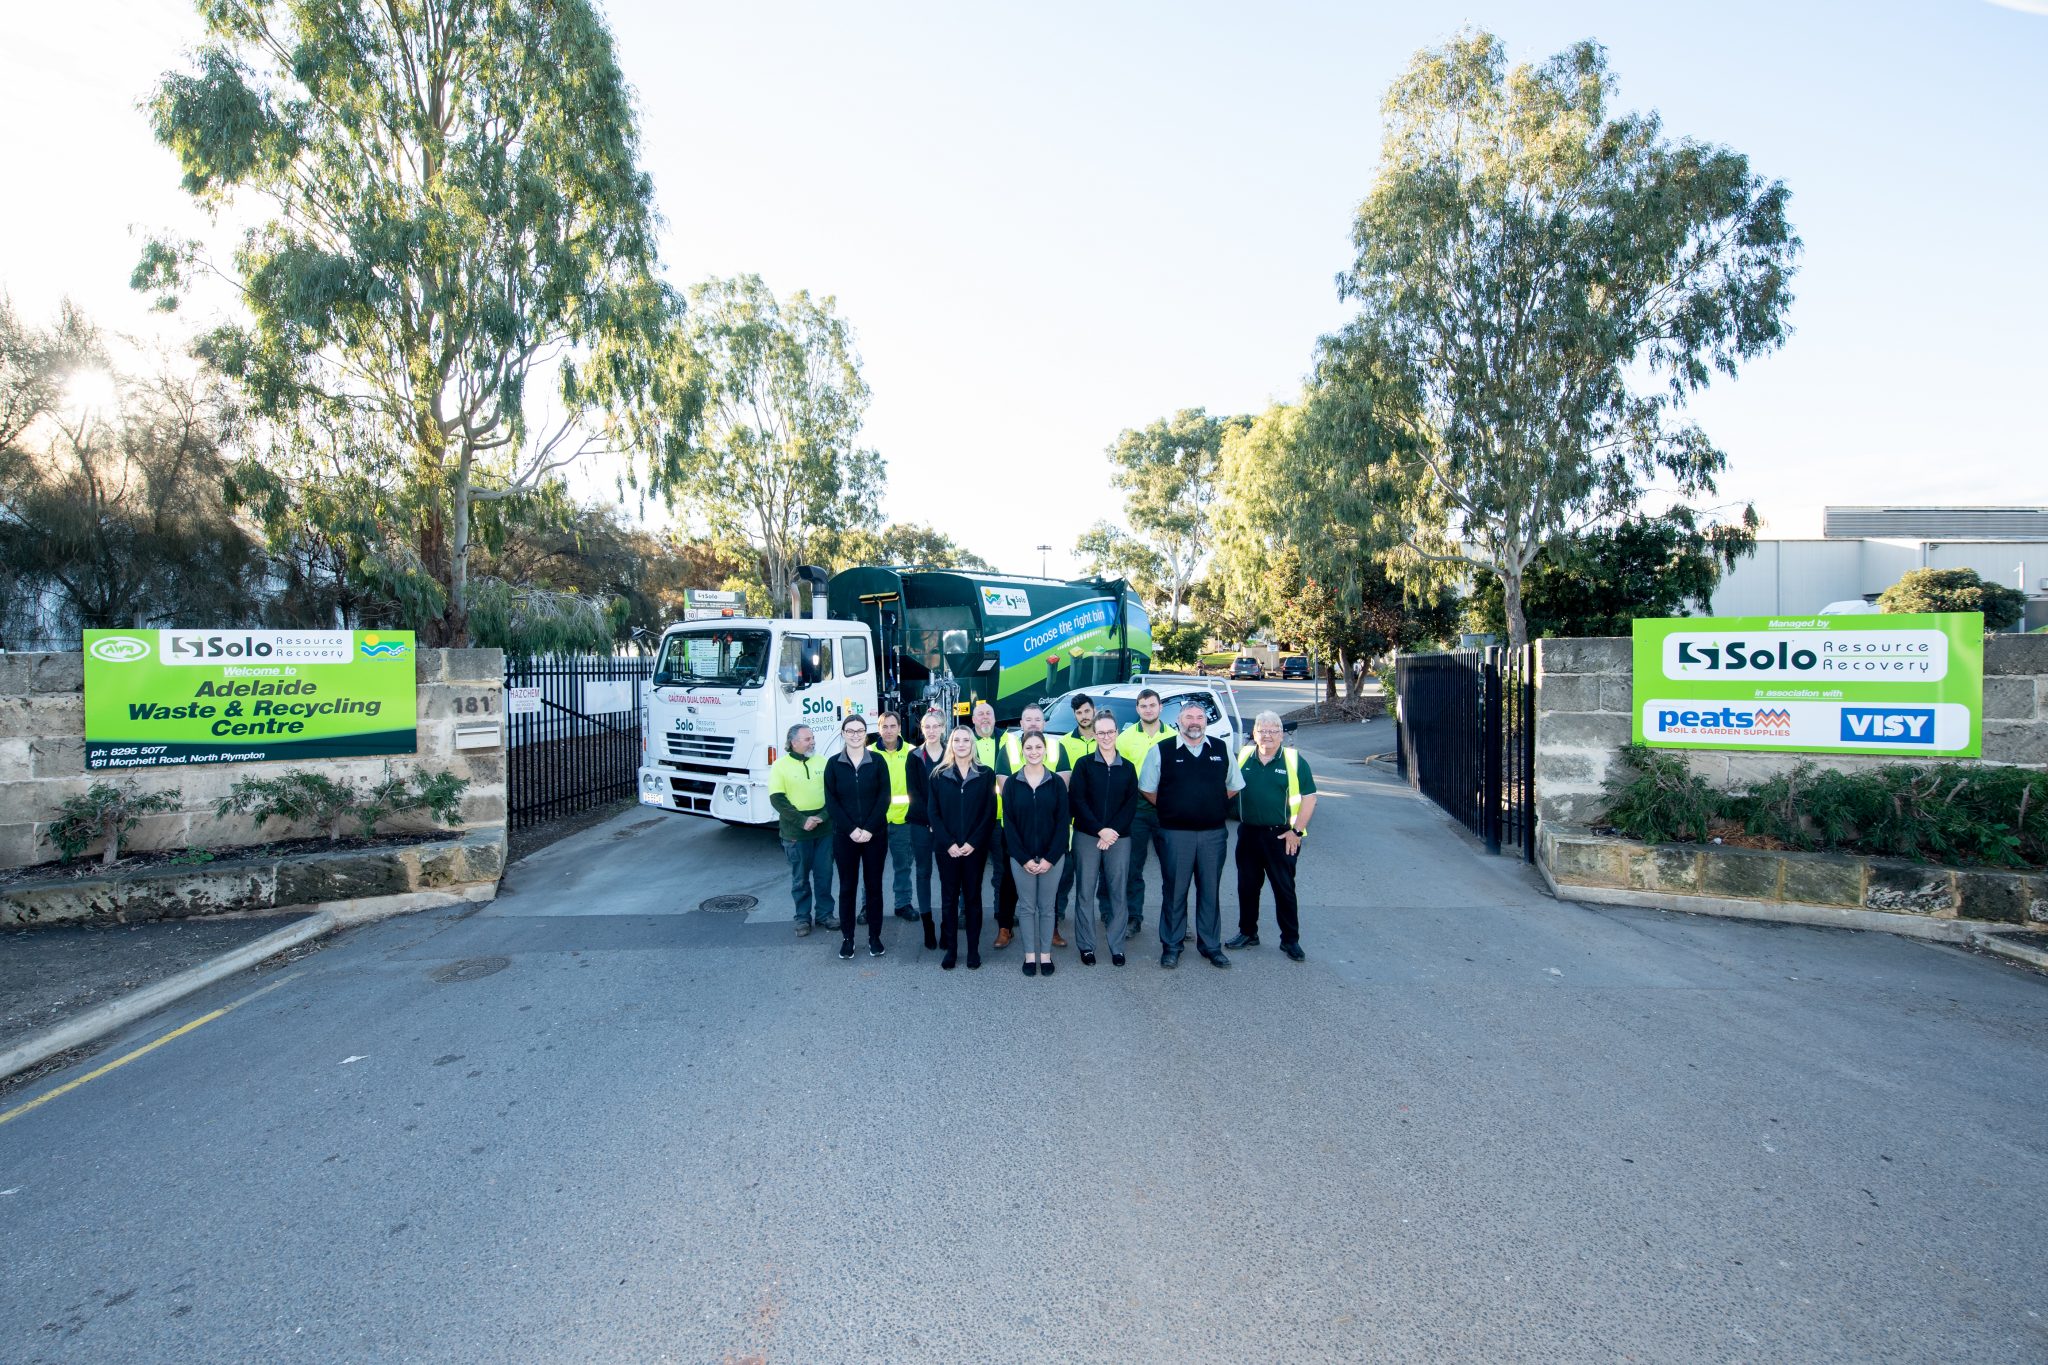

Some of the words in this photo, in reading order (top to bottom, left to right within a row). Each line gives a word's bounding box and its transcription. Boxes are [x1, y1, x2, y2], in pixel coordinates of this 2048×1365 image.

[1023, 628, 1058, 652] Choose
[1058, 620, 1073, 635] the
[1073, 611, 1092, 629] right
[1092, 609, 1105, 621] bin
[1768, 619, 1815, 629] Managed
[1816, 619, 1830, 629] by
[207, 636, 273, 658] Solo
[276, 636, 343, 645] Resource
[1823, 641, 1929, 652] Resource
[276, 648, 343, 659] Recovery
[1725, 641, 1818, 670] Solo
[223, 665, 281, 677] Welcome
[285, 665, 298, 676] to
[1823, 659, 1929, 673] Recovery
[194, 679, 318, 698] Adelaide
[510, 688, 540, 699] HAZCHEM
[1754, 689, 1764, 697] in
[1766, 689, 1820, 698] association
[1822, 689, 1844, 698] with
[452, 696, 490, 714] 181
[668, 694, 687, 703] CAUTION
[686, 695, 700, 704] DUAL
[699, 696, 722, 705] CONTROL
[802, 696, 834, 715] Solo
[128, 702, 217, 721] Waste
[223, 700, 244, 718] &
[252, 698, 382, 719] Recycling
[675, 718, 694, 731] Solo
[802, 716, 834, 725] Resource
[1658, 707, 1754, 732] peats
[1846, 714, 1929, 737] VISY
[211, 717, 305, 737] Centre
[695, 725, 717, 734] Recovery
[1667, 726, 1689, 734] SOIL
[1691, 727, 1698, 735] &
[1700, 728, 1741, 736] GARDEN
[1743, 728, 1791, 737] SUPPLIES
[91, 748, 108, 759] ph:
[110, 747, 138, 756] 8295
[140, 746, 167, 755] 5077
[91, 759, 107, 767] 181
[109, 756, 156, 767] Morphett
[158, 755, 187, 764] Road,
[190, 753, 218, 763] North
[220, 752, 265, 762] Plympton
